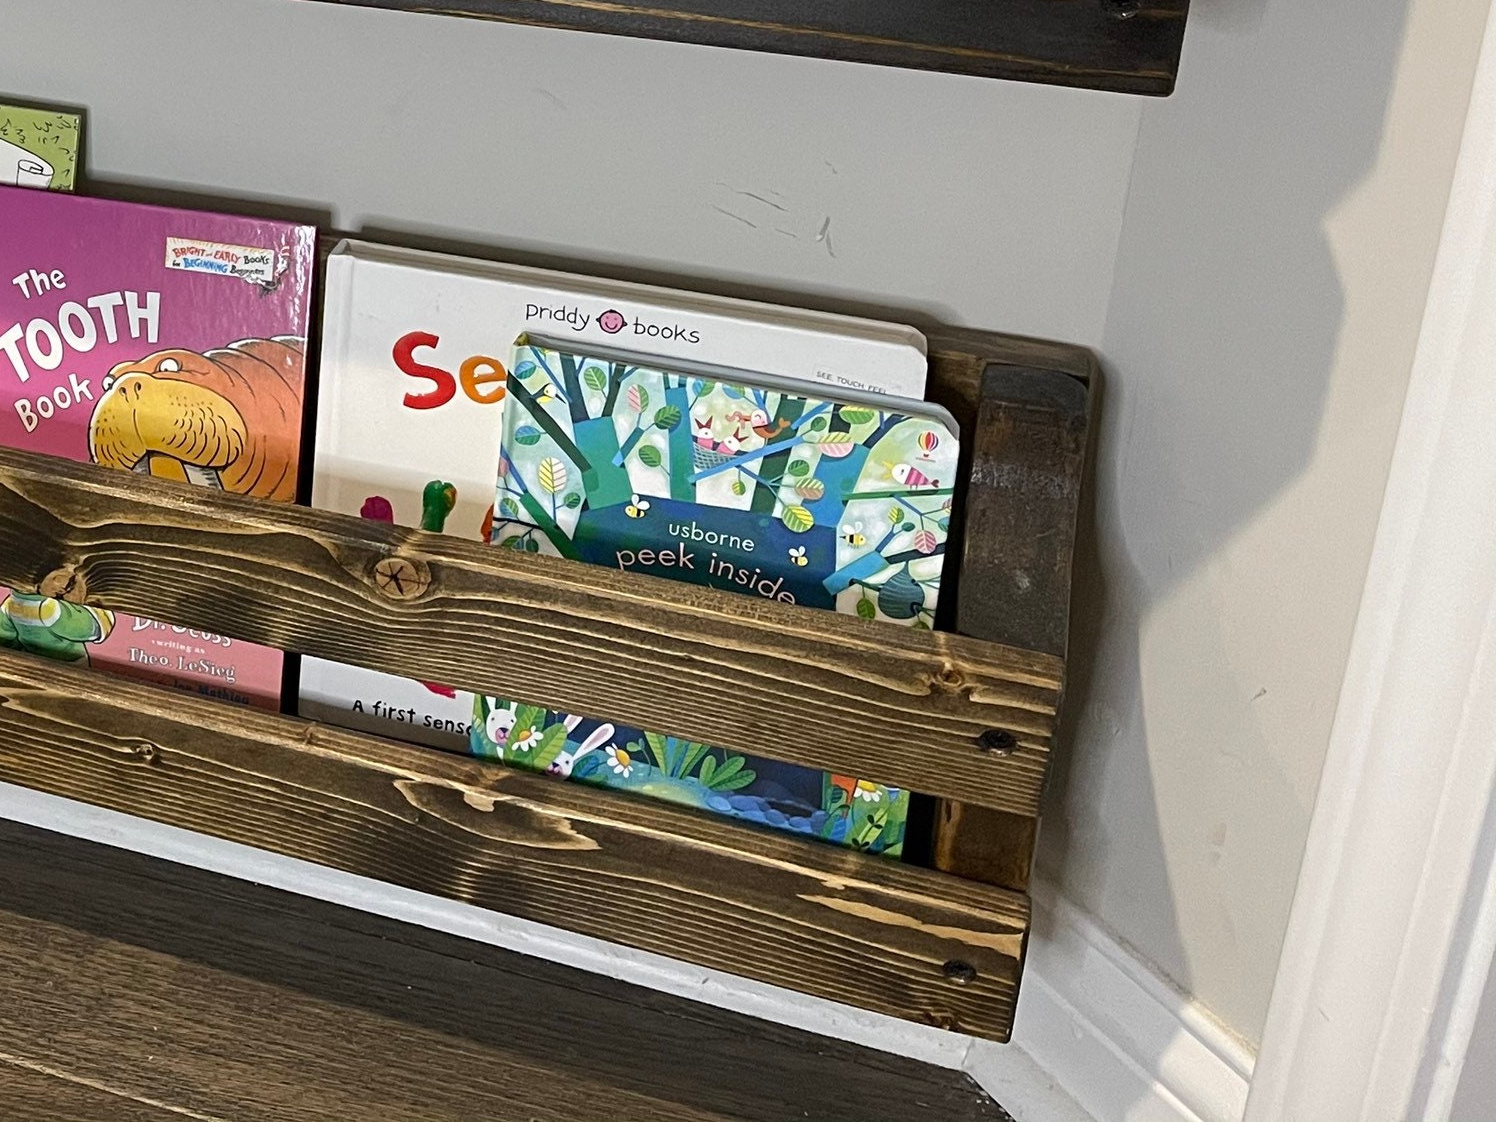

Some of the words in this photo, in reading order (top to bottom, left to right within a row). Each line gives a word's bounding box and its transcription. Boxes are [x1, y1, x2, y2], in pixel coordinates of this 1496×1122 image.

[12, 268, 66, 299] The
[525, 304, 590, 331] priddy
[633, 316, 701, 344] books
[14, 373, 95, 433] Book
[669, 522, 755, 553] usborne
[616, 542, 695, 571] peek
[708, 553, 796, 606] inside
[156, 641, 192, 653] writing
[129, 648, 173, 667] Theo.
[176, 655, 236, 684] LeSieg
[352, 700, 364, 713] A
[372, 700, 416, 724] first
